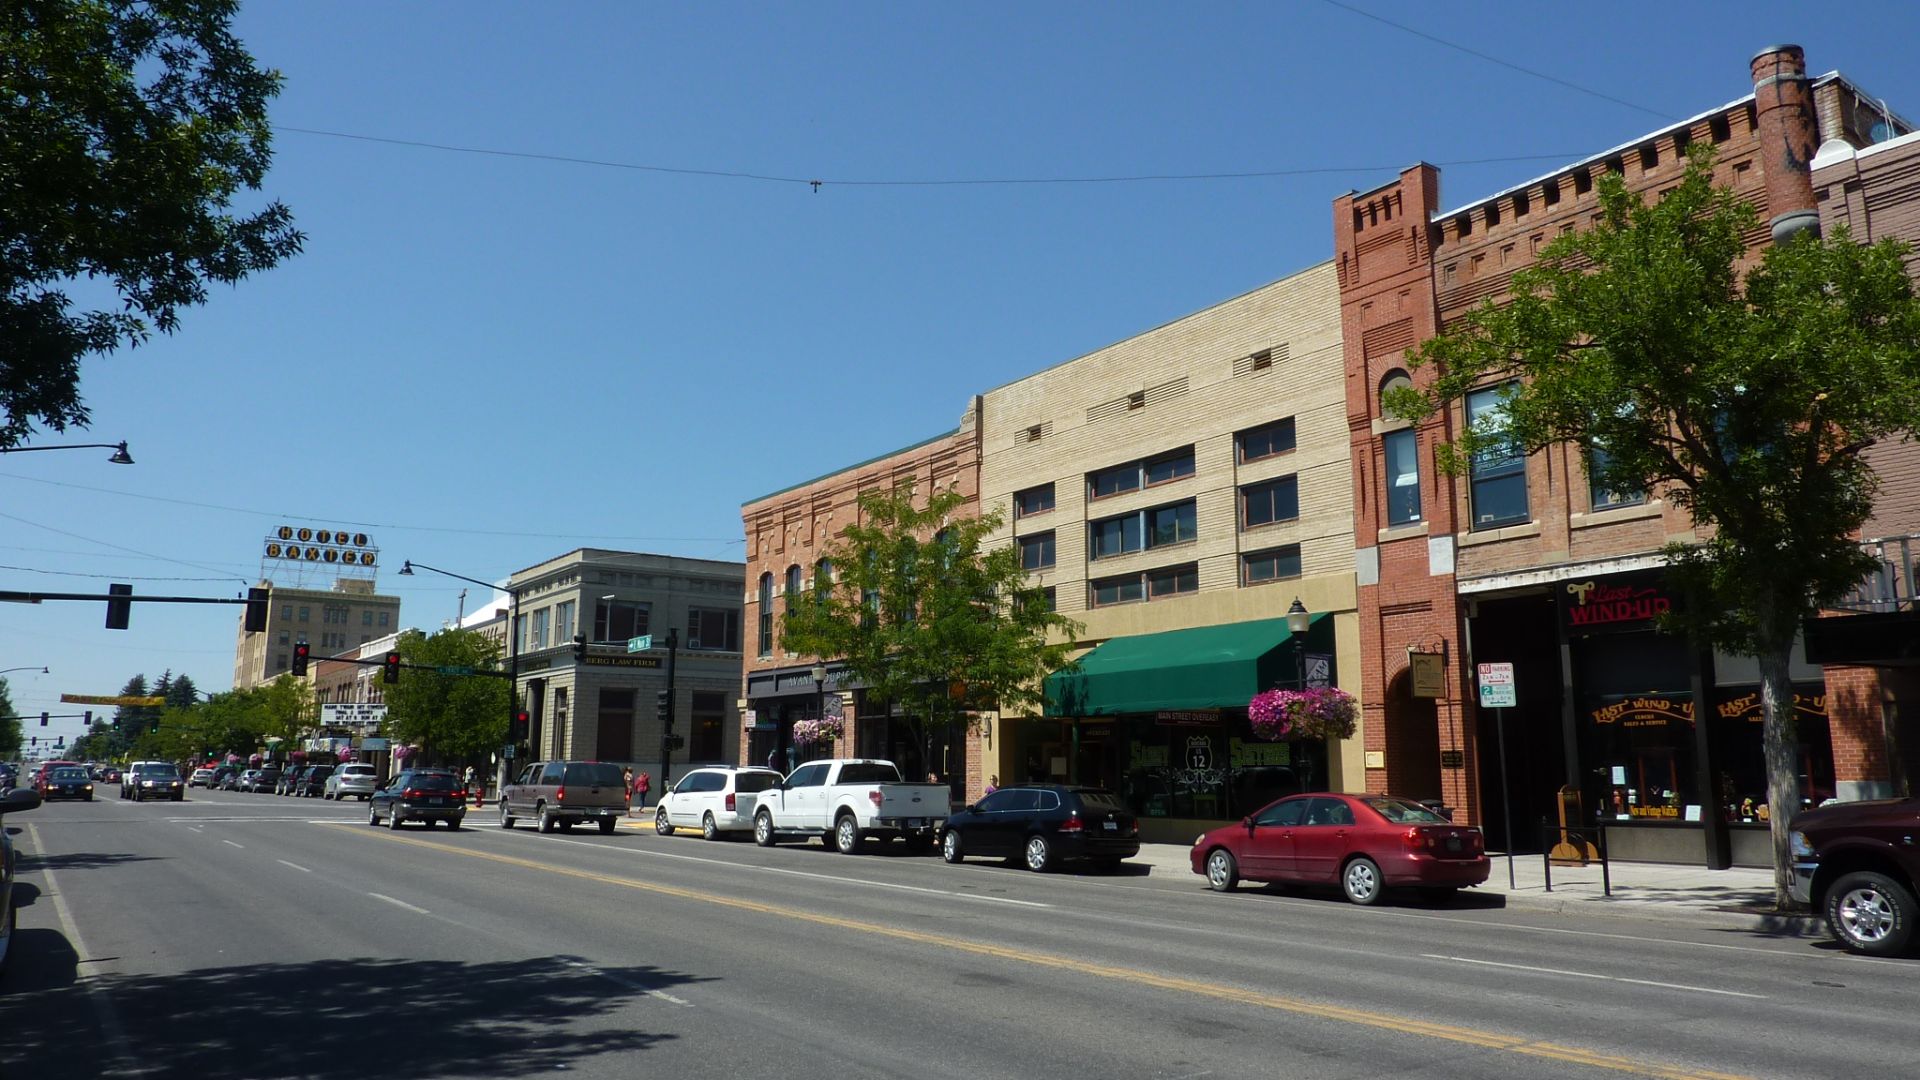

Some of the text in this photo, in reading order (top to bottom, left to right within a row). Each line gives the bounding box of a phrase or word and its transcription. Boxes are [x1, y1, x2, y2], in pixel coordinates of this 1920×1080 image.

[281, 527, 364, 547] HOTEL
[270, 544, 373, 565] BAXTER
[633, 659, 656, 667] FIRM
[1481, 665, 1490, 674] NO
[1484, 687, 1491, 695] 2
[1158, 712, 1171, 720] MAIN
[1172, 712, 1191, 721] STREET
[1192, 755, 1206, 768] 12
